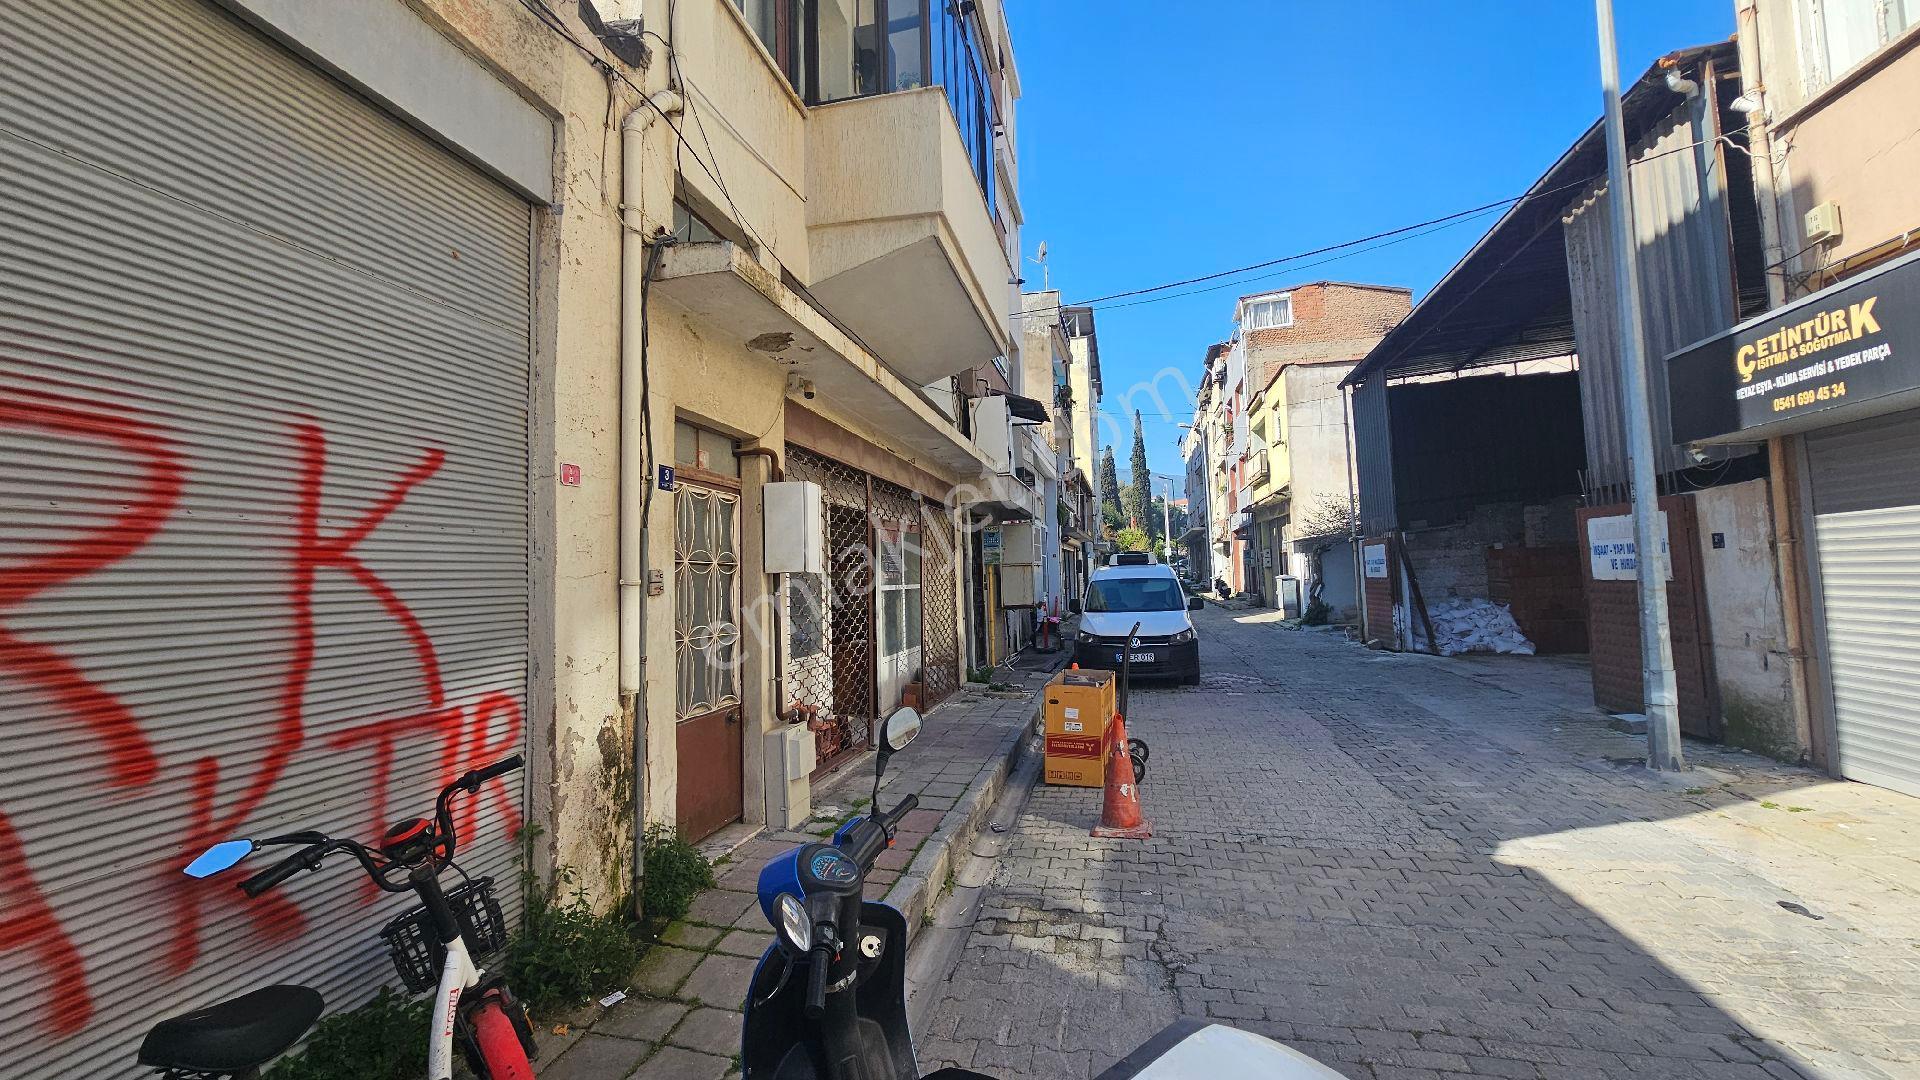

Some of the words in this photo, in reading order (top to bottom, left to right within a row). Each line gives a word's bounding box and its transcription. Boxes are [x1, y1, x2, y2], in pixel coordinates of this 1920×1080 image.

[1736, 296, 1882, 383] ÇETİNTÜRK
[1757, 352, 1789, 371] ISITMA
[1789, 347, 1799, 360] &
[1799, 329, 1852, 357] SOĞUTMA
[1756, 379, 1774, 396] EŞYA
[1776, 371, 1798, 388] KLİMA
[1798, 360, 1827, 382] SERVİSİ
[1827, 360, 1835, 373] &
[1834, 351, 1863, 371] YEDEK
[1863, 342, 1892, 363] PARÇA
[1773, 394, 1796, 412] 0541
[1797, 389, 1815, 406] 699
[1816, 385, 1830, 401] 45
[1831, 381, 1846, 399] 34
[664, 469, 670, 481] 3
[1610, 558, 1619, 570] VE
[1612, 543, 1626, 555] YAPI
